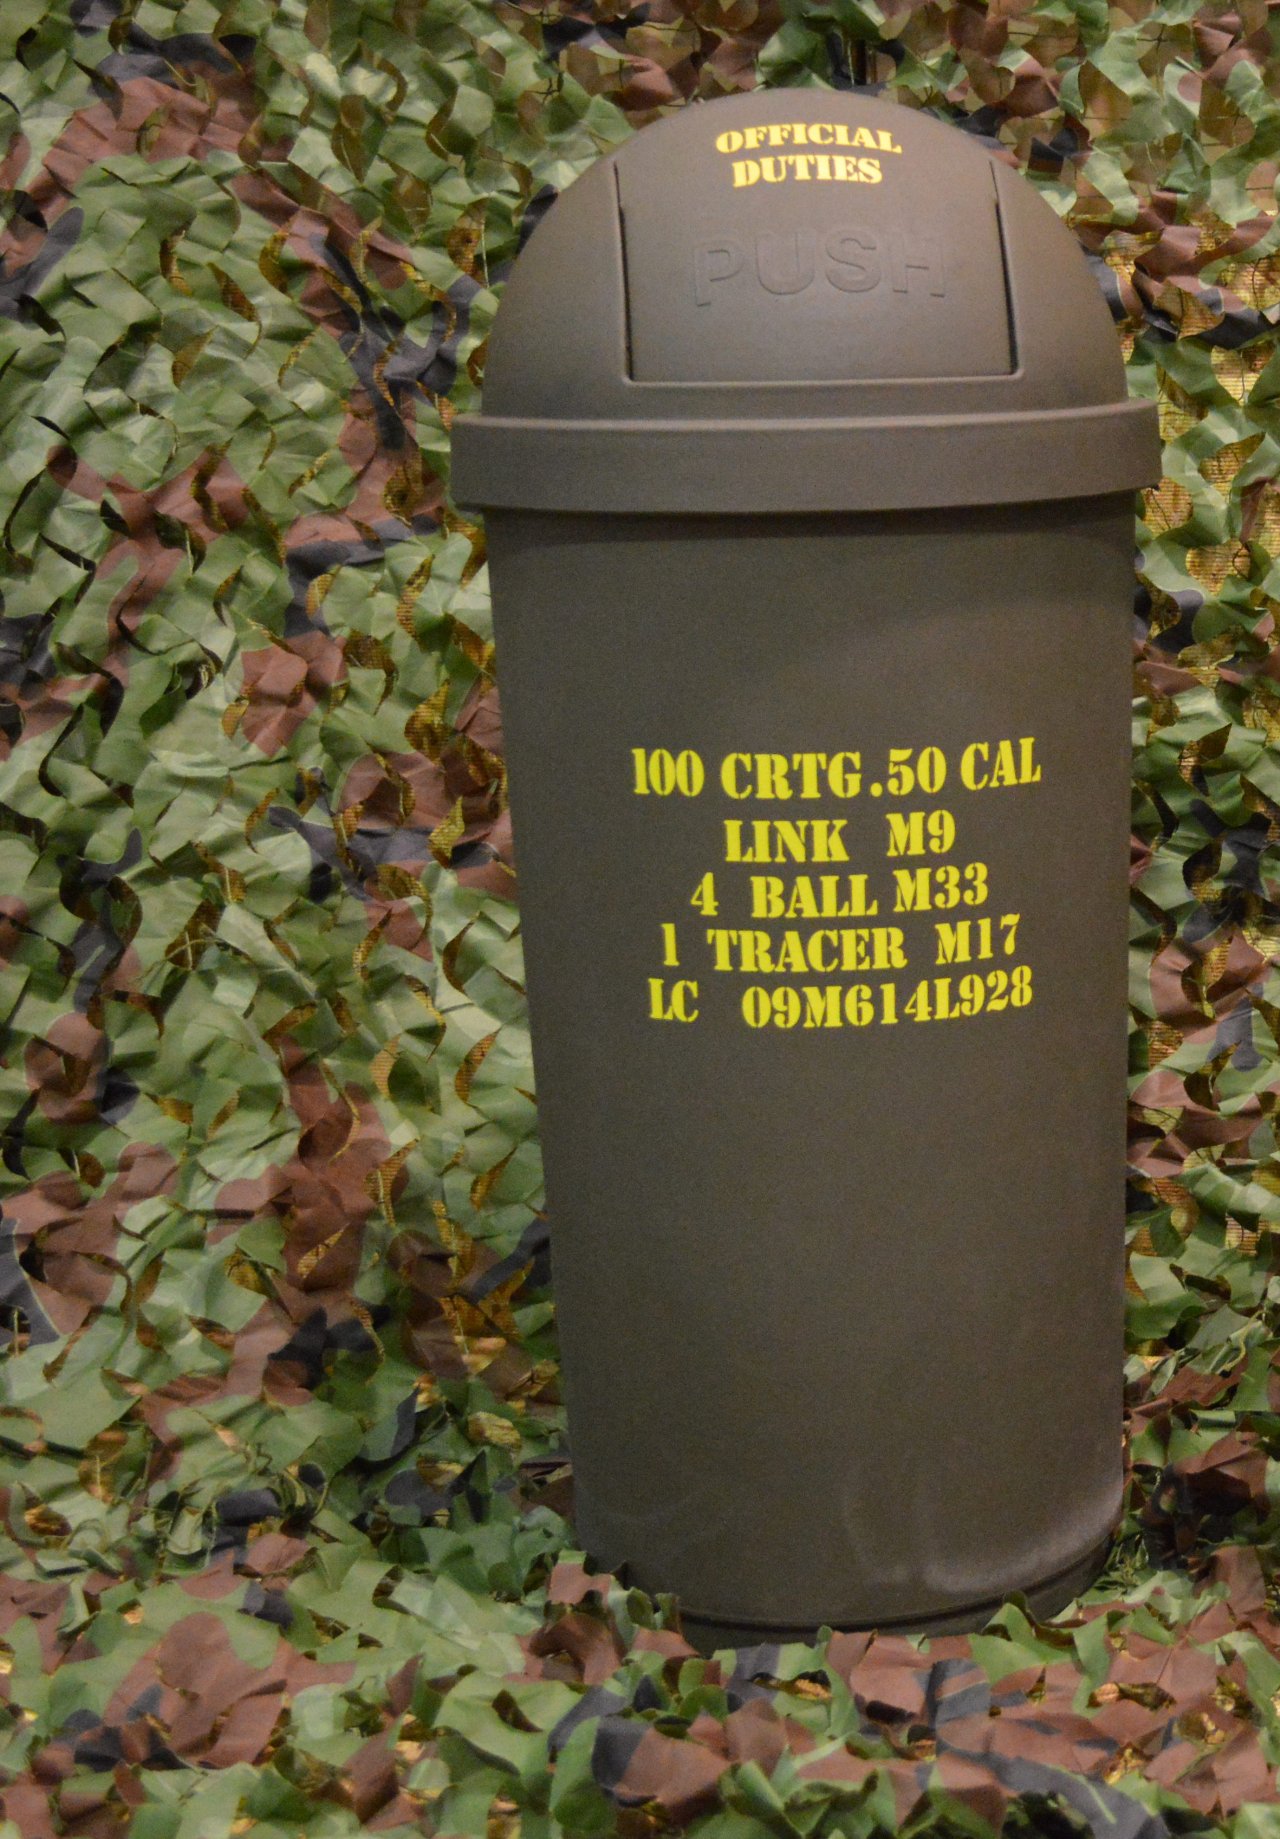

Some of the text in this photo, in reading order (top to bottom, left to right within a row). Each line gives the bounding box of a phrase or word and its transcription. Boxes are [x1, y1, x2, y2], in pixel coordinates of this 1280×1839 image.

[715, 122, 903, 154] OFFICIAL
[732, 154, 883, 188] DUTIES
[694, 230, 947, 307] PUSH
[631, 747, 705, 798] 100
[959, 736, 1043, 792] CAL
[723, 809, 957, 864] LINK M9
[690, 861, 989, 920] 4 BALL M33
[660, 912, 1021, 974] 1 TRACER M17
[647, 965, 1034, 1029] LC 09M614L928
